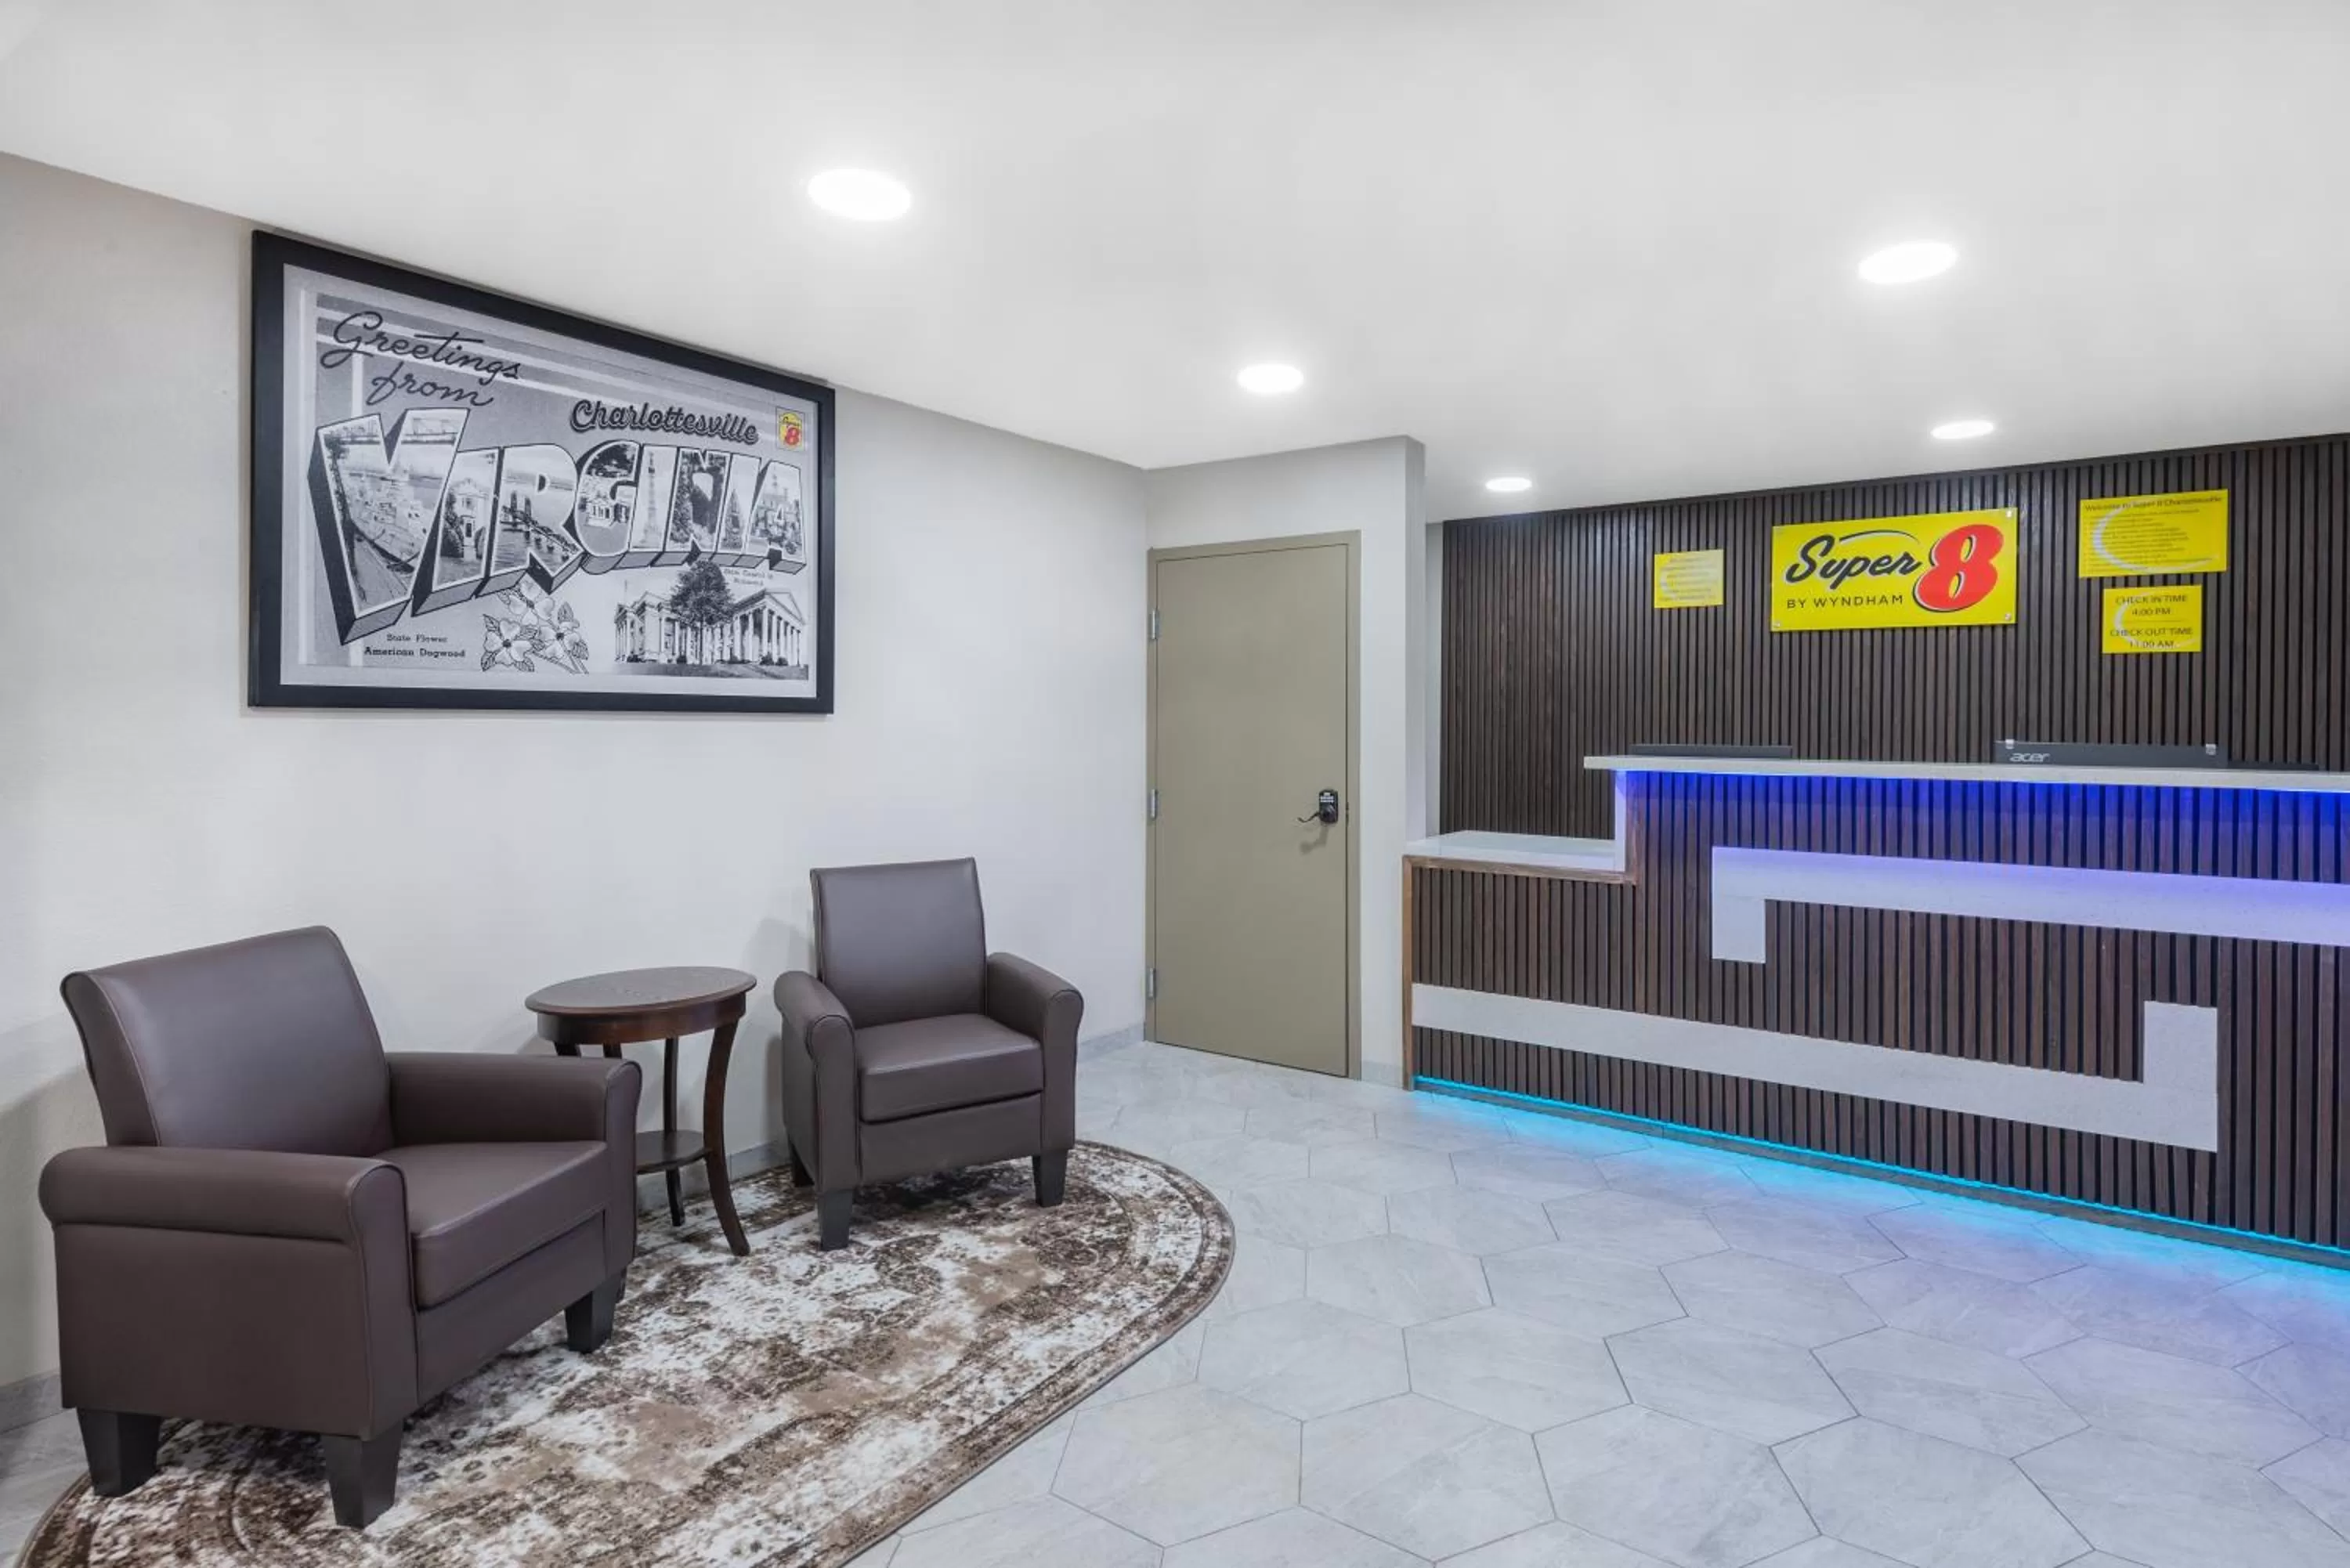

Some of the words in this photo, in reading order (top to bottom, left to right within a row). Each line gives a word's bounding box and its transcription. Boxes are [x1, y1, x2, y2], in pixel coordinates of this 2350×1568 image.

[320, 311, 521, 386] Greetings
[365, 360, 494, 406] from
[570, 399, 759, 444] Charlottesville
[308, 406, 807, 645] VIRGINIA
[1785, 533, 1923, 591] Super
[1912, 524, 2005, 612] 8
[1787, 598, 1806, 609] BY
[1813, 594, 1904, 609] WYNDHAM
[2115, 595, 2149, 604] CHECK
[2164, 594, 2188, 602] TIME
[416, 634, 448, 643] Flower
[2110, 628, 2142, 637] CHECK
[2145, 627, 2166, 636] OUT
[2167, 627, 2193, 636] TIME
[2157, 640, 2175, 649] AM
[363, 646, 414, 656] American
[419, 648, 466, 659] Dogwood
[2009, 753, 2051, 763] acer
